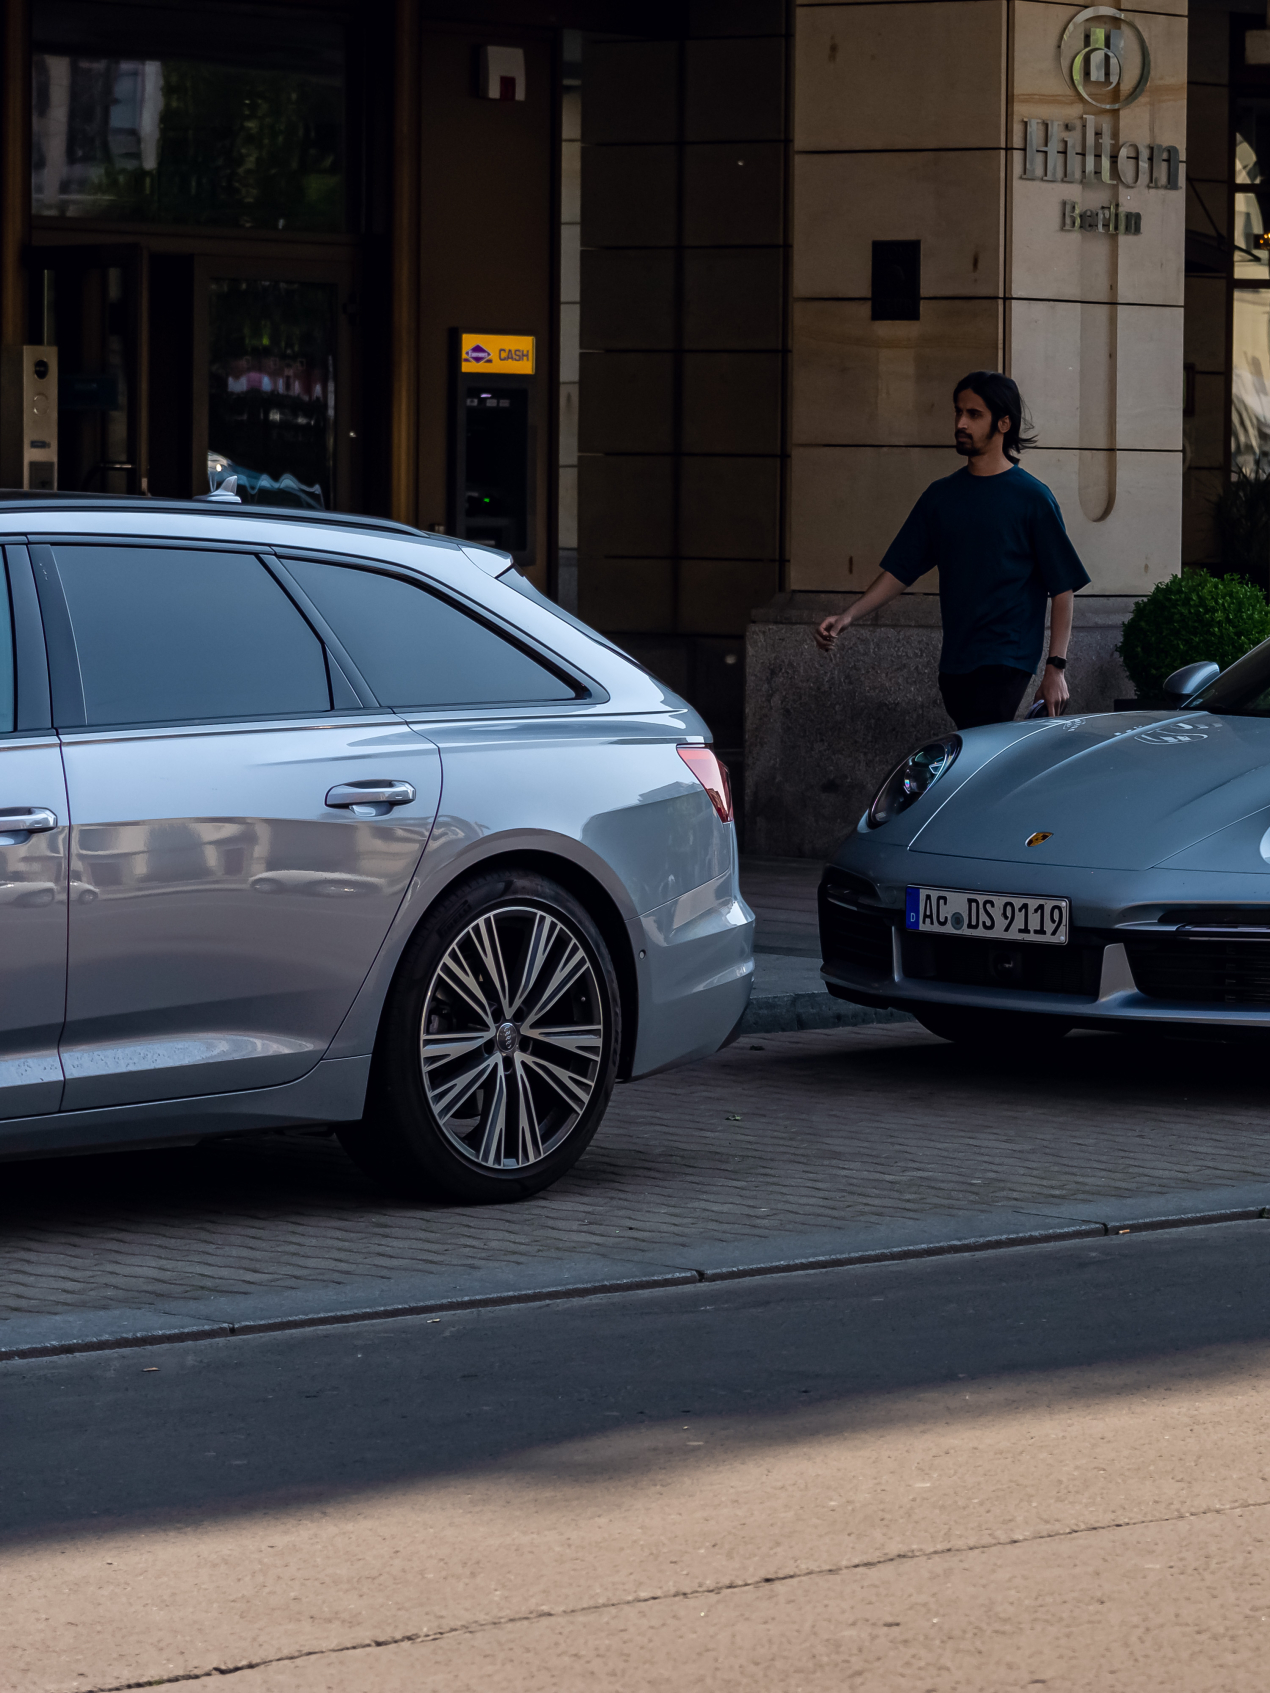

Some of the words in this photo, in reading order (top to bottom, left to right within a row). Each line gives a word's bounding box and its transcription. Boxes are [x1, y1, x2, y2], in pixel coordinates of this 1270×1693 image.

[1021, 115, 1182, 190] Hilton
[1062, 199, 1142, 235] Berlin
[499, 348, 529, 361] CASH
[921, 894, 949, 927] AC
[966, 897, 996, 931] DS
[1002, 901, 1064, 937] 9119
